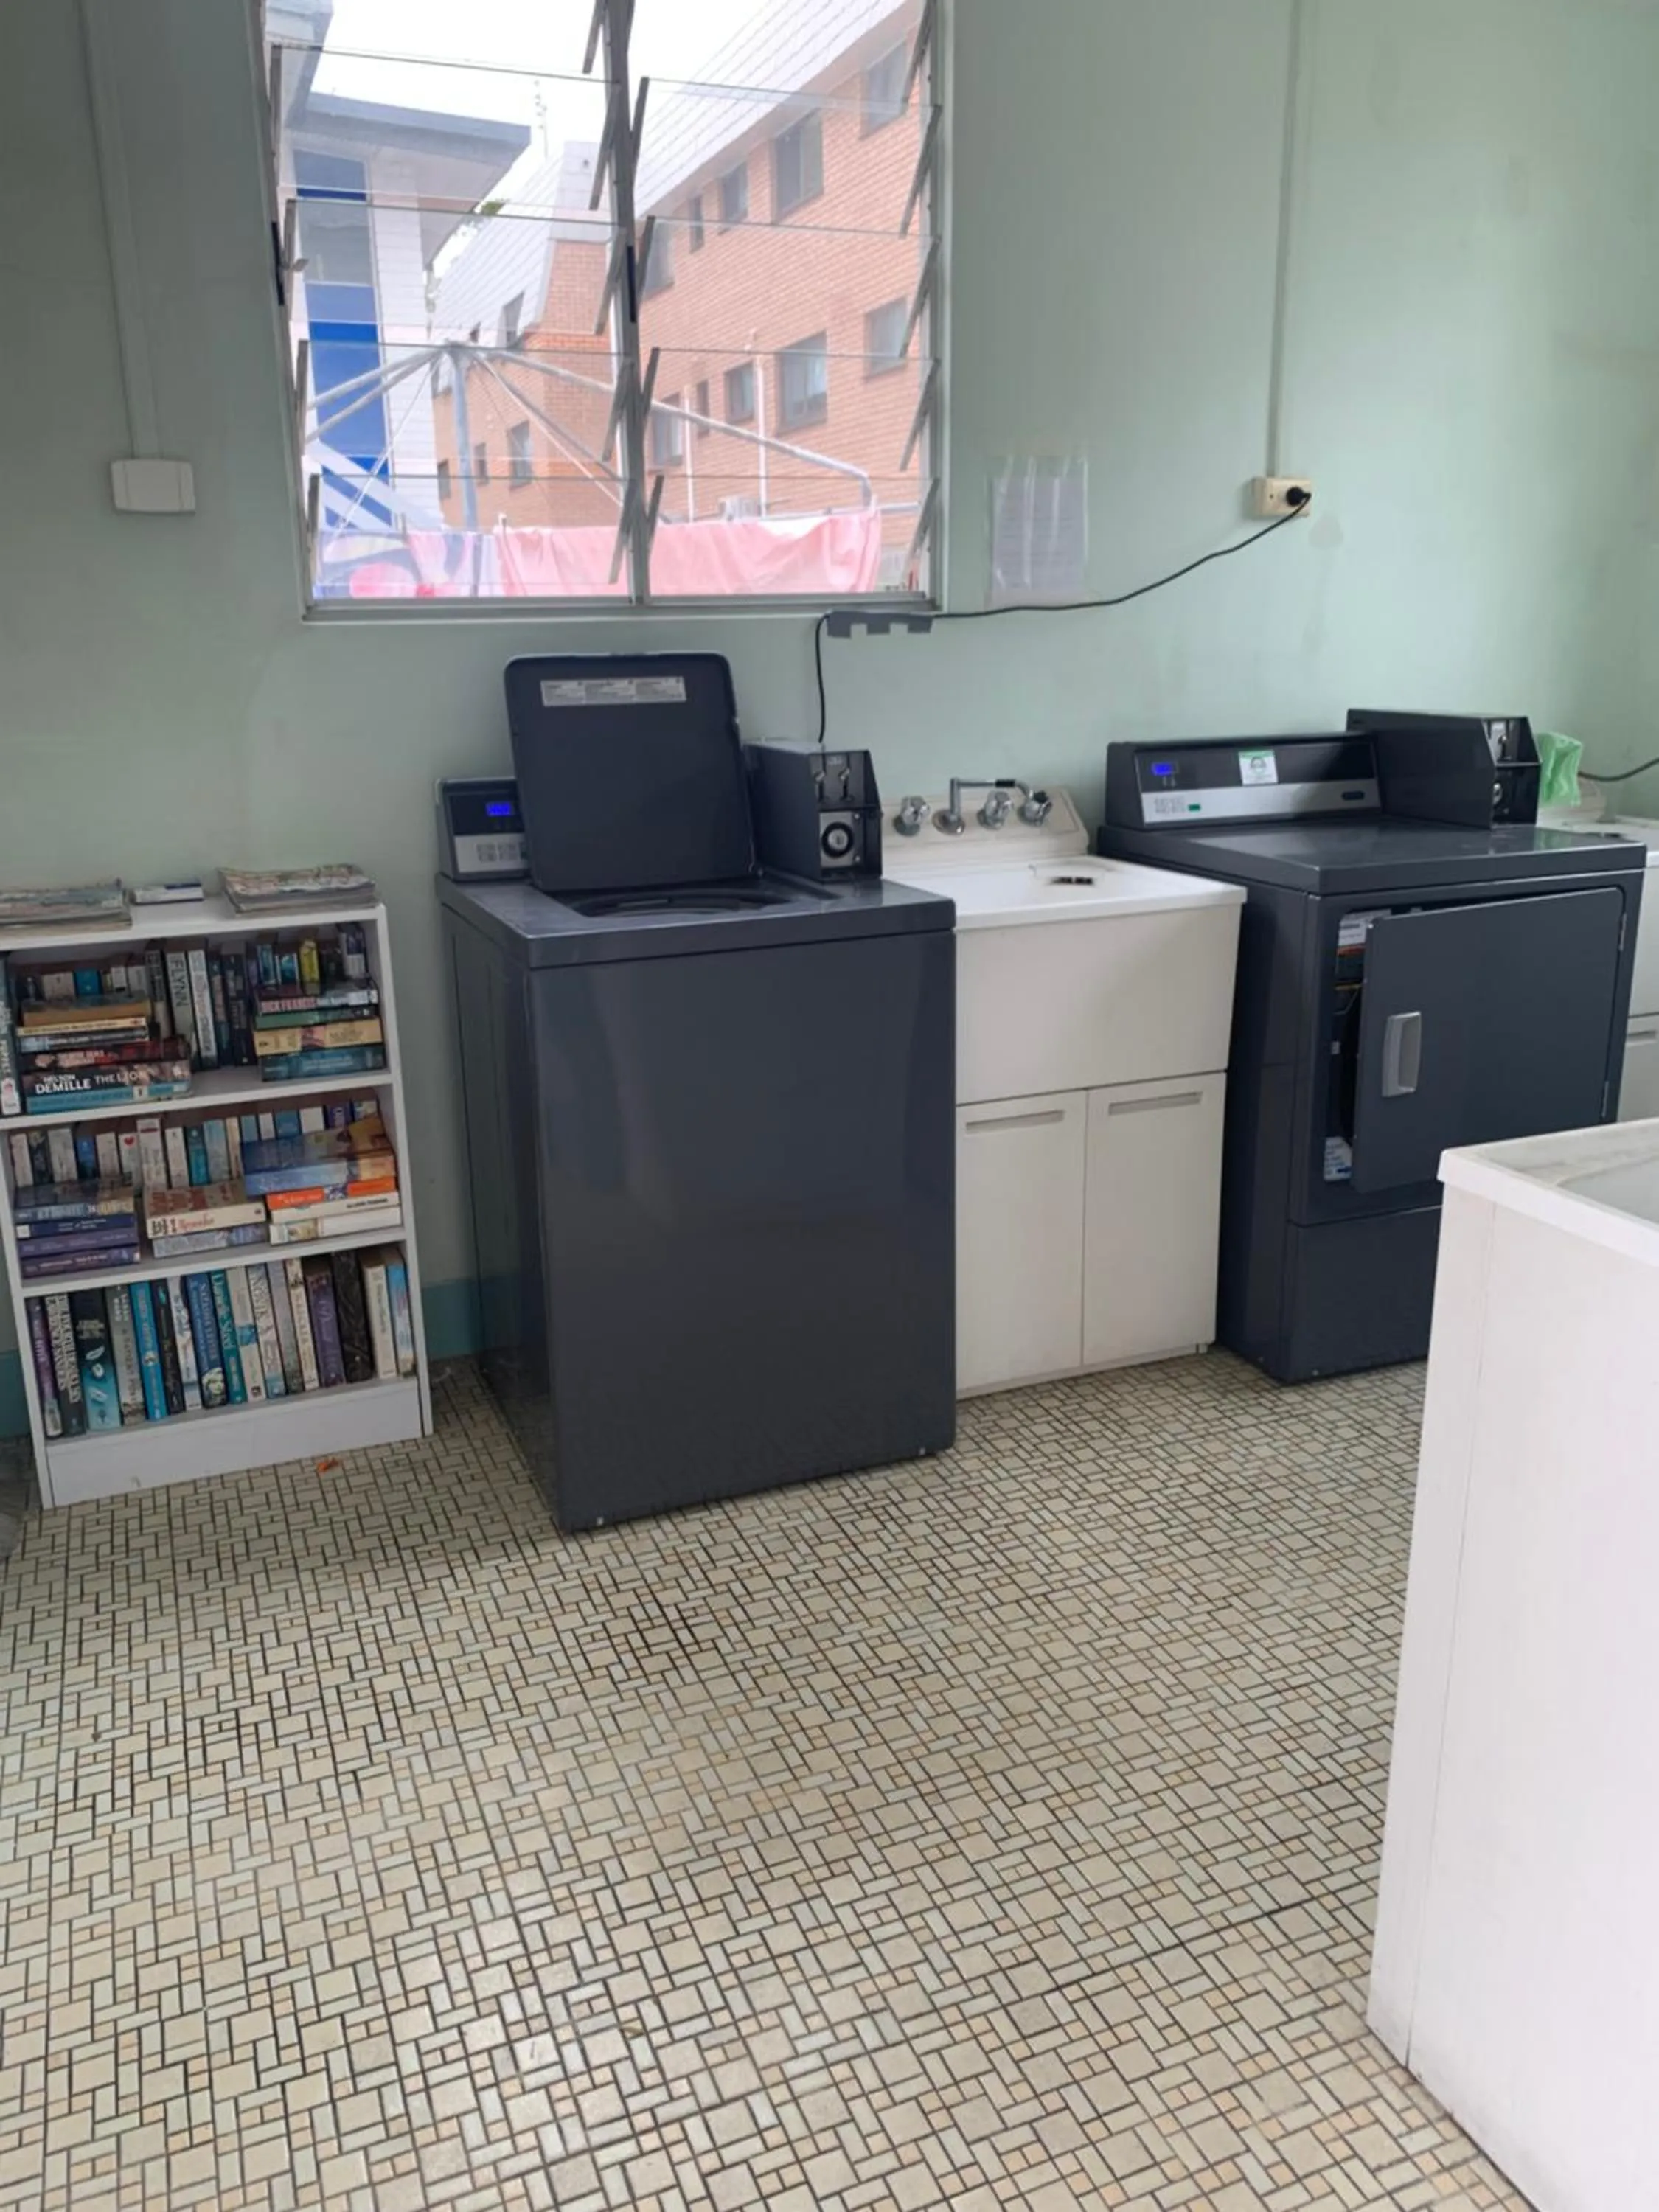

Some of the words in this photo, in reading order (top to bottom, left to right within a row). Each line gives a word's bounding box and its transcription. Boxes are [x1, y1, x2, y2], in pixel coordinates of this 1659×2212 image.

[170, 957, 189, 1007] FLYNN
[36, 1079, 91, 1094] DEMILLE
[95, 1074, 115, 1084] THE
